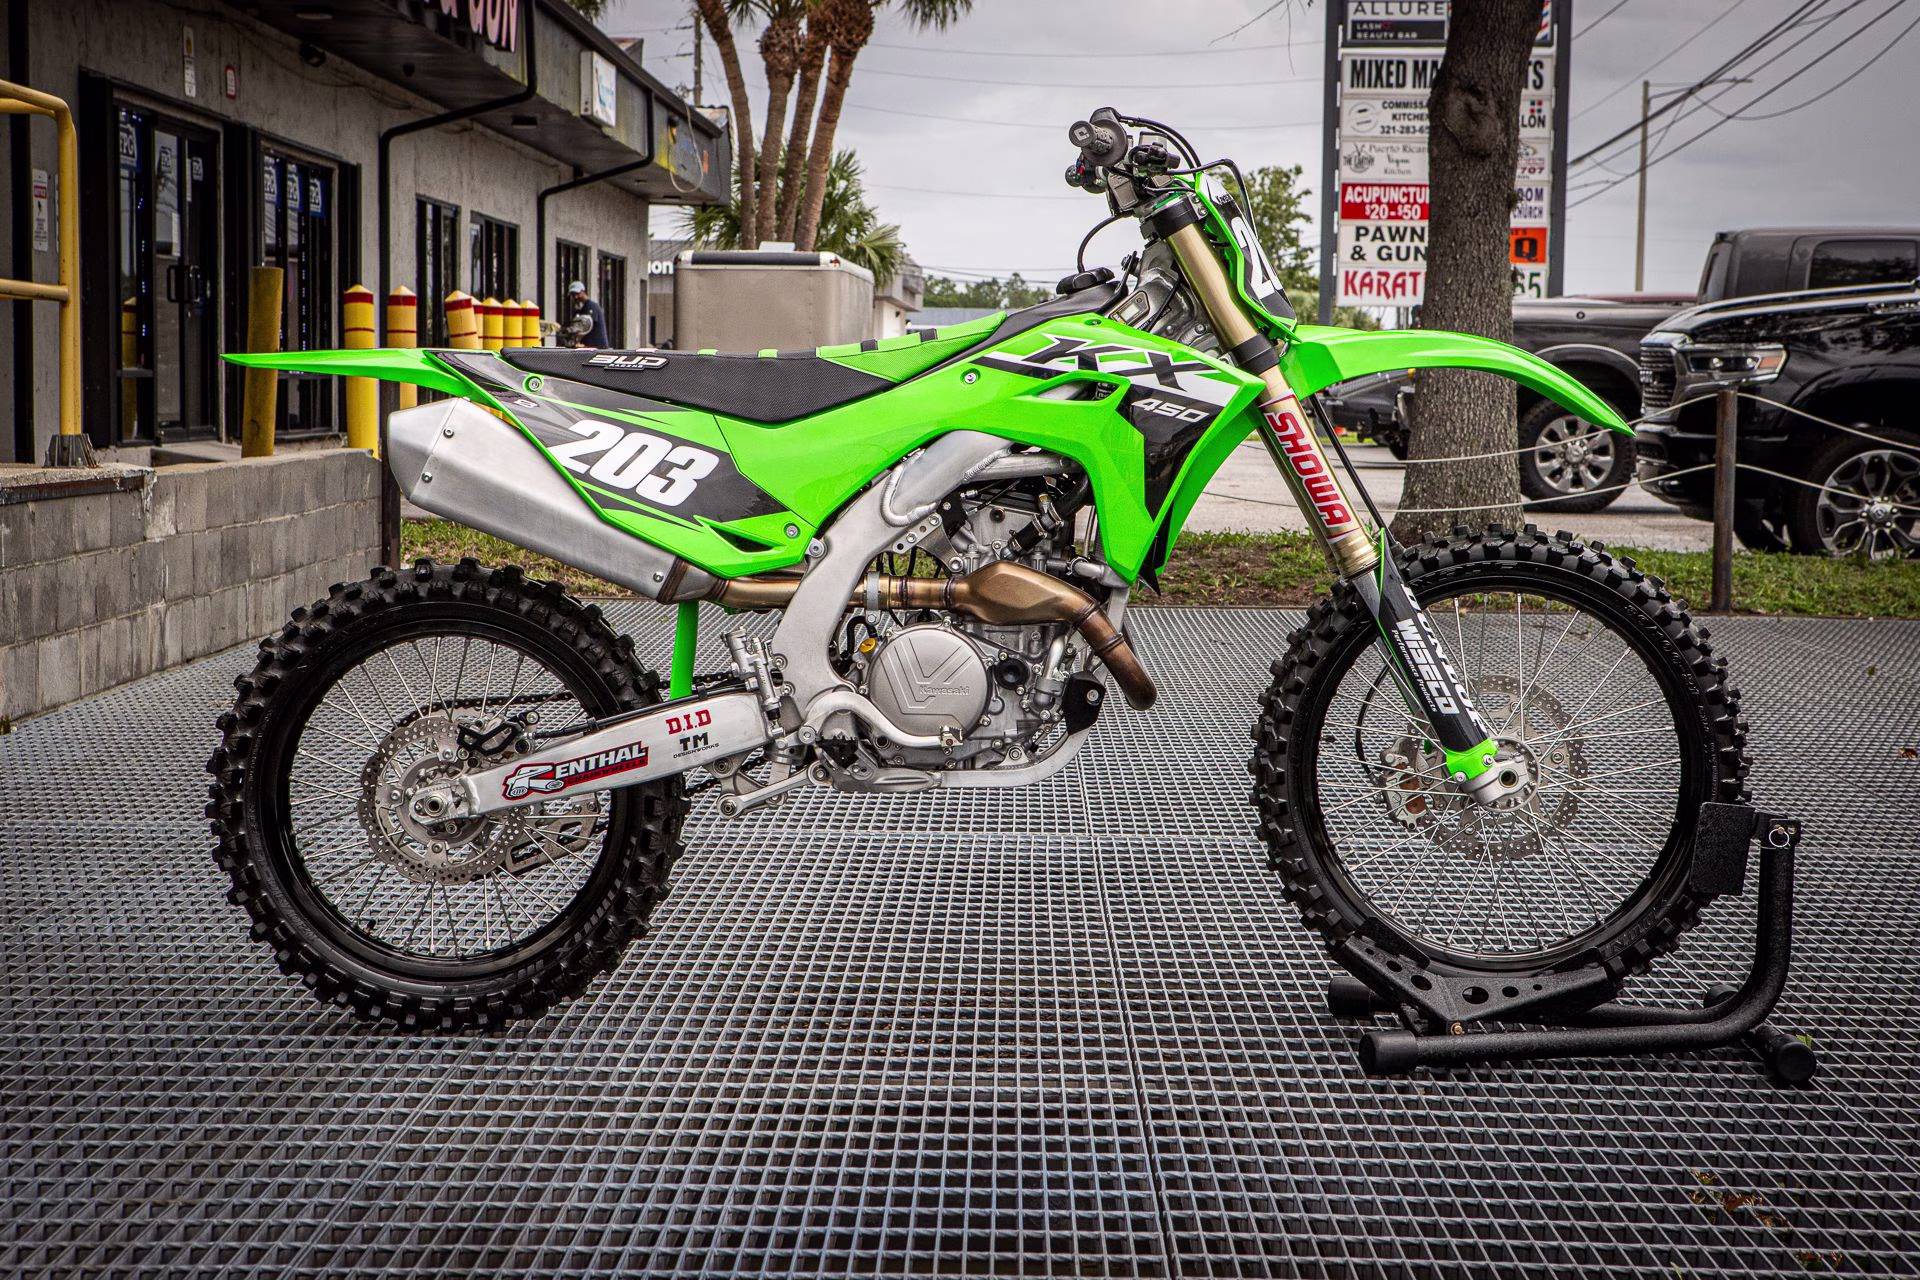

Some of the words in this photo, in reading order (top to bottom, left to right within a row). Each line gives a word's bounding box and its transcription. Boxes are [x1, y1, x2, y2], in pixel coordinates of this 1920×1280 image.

[1353, 1, 1444, 15] ALLURE
[1356, 22, 1382, 30] LASH
[1356, 31, 1394, 39] BEAUTY
[1397, 31, 1418, 39] BAR
[1350, 59, 1407, 89] MIXED
[1412, 59, 1440, 89] MA
[1382, 101, 1428, 109] COMMISS
[1521, 115, 1546, 128] LON
[1344, 186, 1429, 204] ACUPUNCTU
[1355, 226, 1425, 242] PAWN
[1350, 246, 1367, 261] &
[1344, 270, 1426, 300] KARAT
[1020, 333, 1222, 392] KX
[1131, 398, 1211, 423] 450
[546, 419, 720, 507] 203
[1265, 411, 1352, 527] SHOWA
[1391, 629, 1420, 678] Performance
[919, 684, 970, 696] Kawasaki
[665, 709, 712, 735] D.I.D
[680, 732, 709, 751] TM
